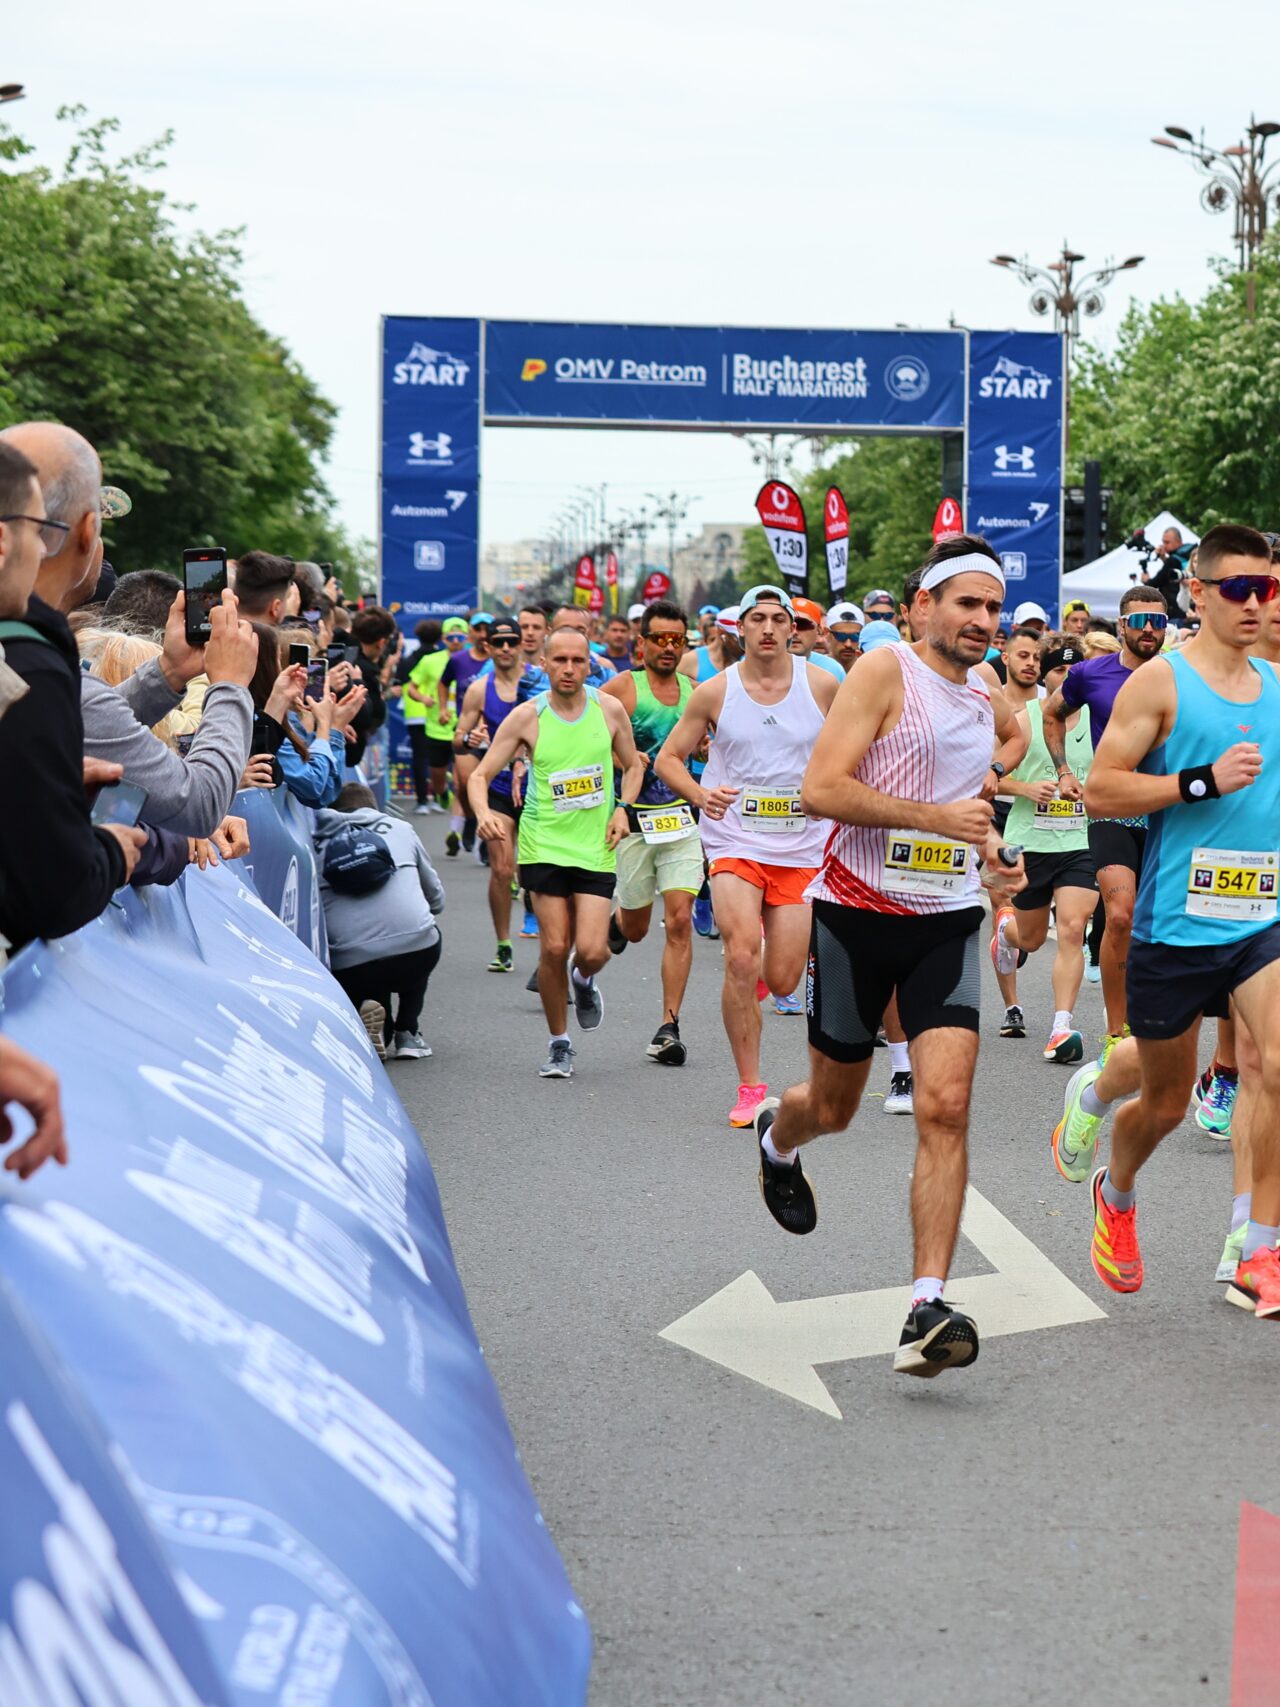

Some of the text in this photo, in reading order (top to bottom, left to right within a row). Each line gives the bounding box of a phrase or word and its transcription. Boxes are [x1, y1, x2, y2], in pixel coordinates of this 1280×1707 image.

[393, 363, 470, 386] START
[555, 357, 614, 379] OMV
[621, 359, 706, 382] Petrom
[733, 353, 867, 382] Bucharest
[733, 379, 867, 399] HALF MARATHON
[979, 376, 1051, 399] START
[391, 504, 448, 518] Autonom
[977, 516, 1030, 528] Autonom
[774, 536, 803, 559] 1:30
[431, 602, 470, 615] Petrom
[566, 779, 592, 792] 2741
[761, 801, 789, 811] 1805
[1050, 803, 1074, 813] 2548
[655, 817, 678, 830] 837
[915, 846, 952, 864] 1012
[1217, 870, 1257, 891] 547
